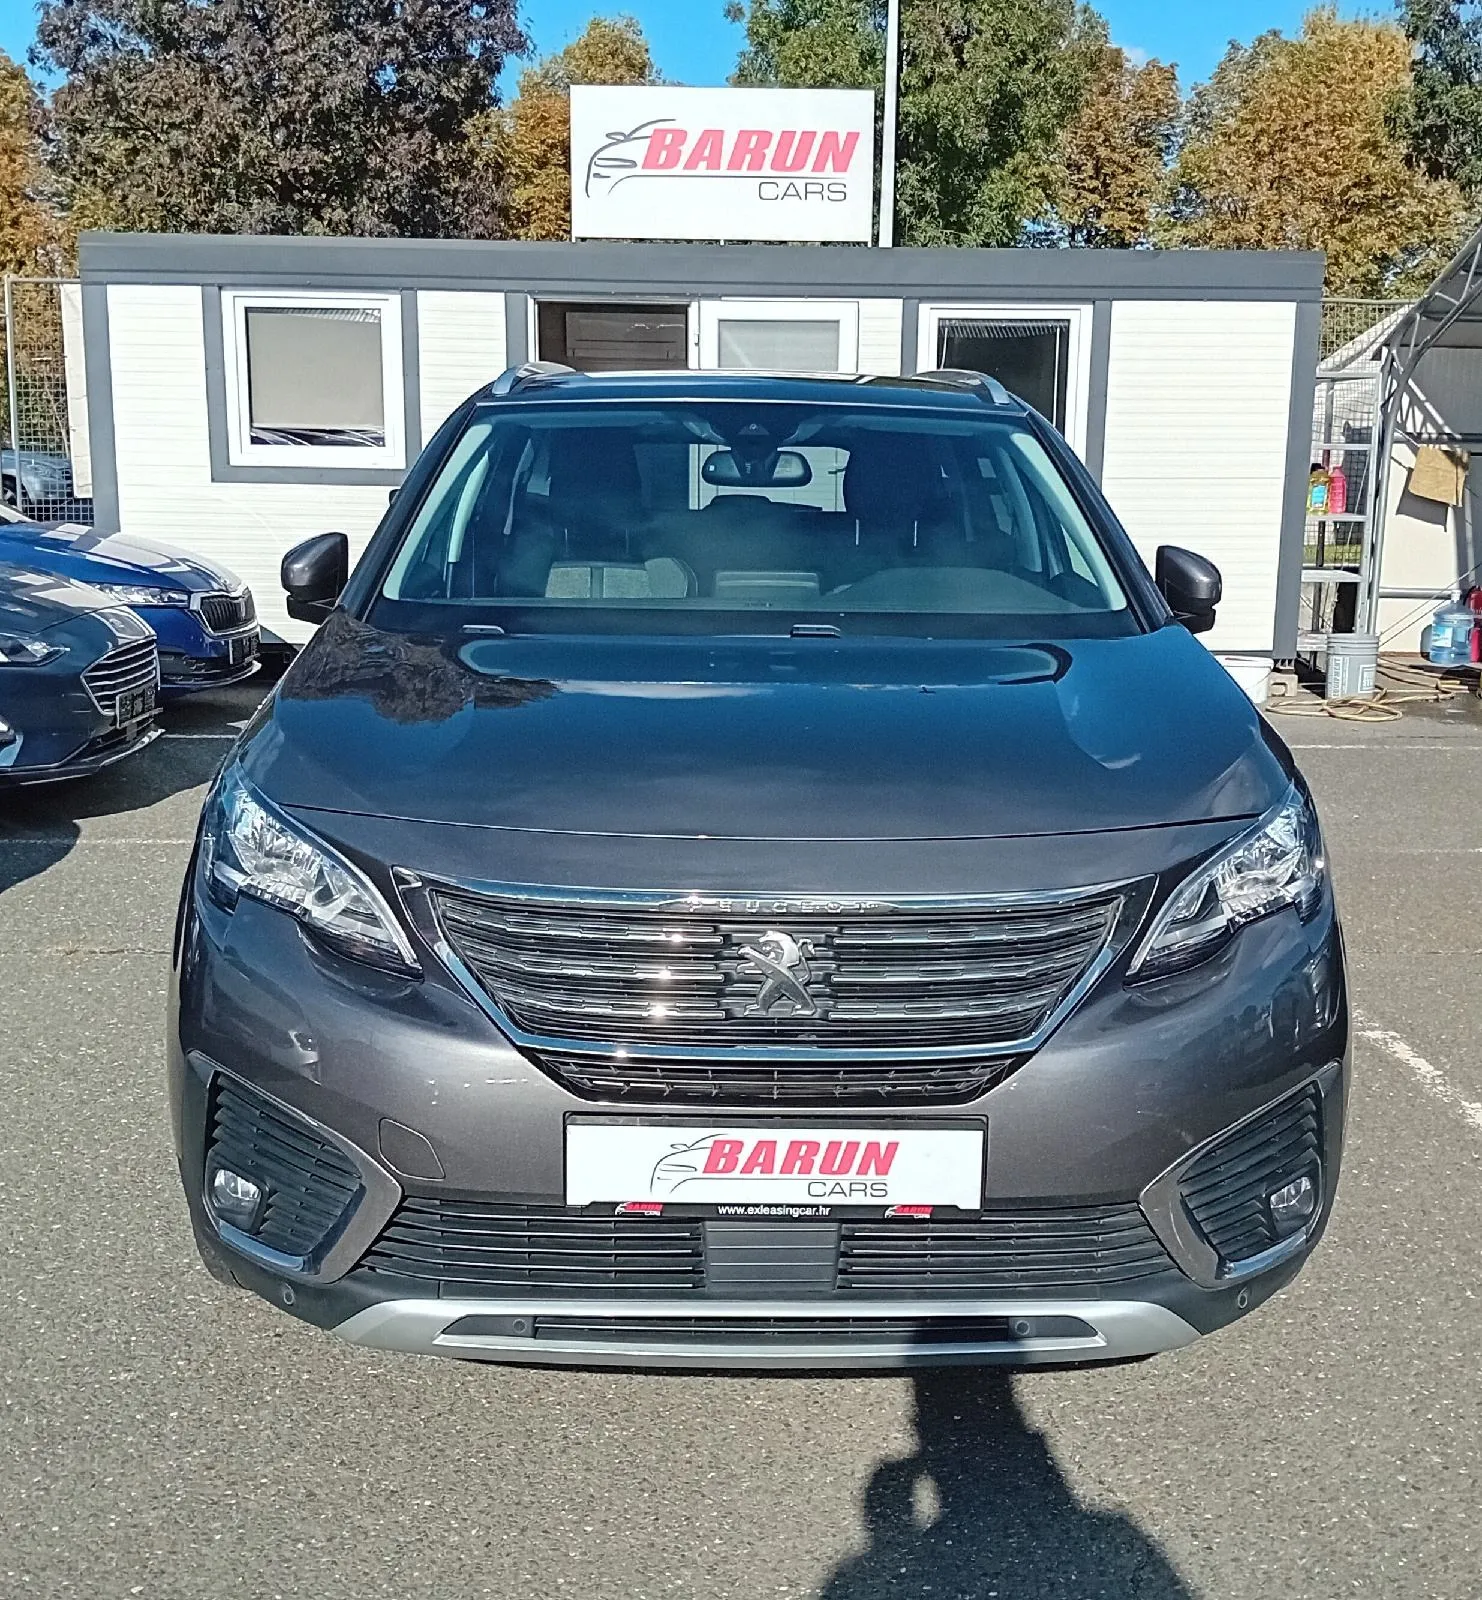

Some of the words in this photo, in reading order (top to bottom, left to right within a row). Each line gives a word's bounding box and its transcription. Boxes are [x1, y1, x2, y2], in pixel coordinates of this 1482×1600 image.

[641, 128, 860, 173] BARUN
[758, 181, 847, 202] CARS
[702, 1139, 900, 1176] BARUN
[807, 1181, 889, 1198] CARS
[717, 1204, 831, 1218] www.exleasingcar.hr
